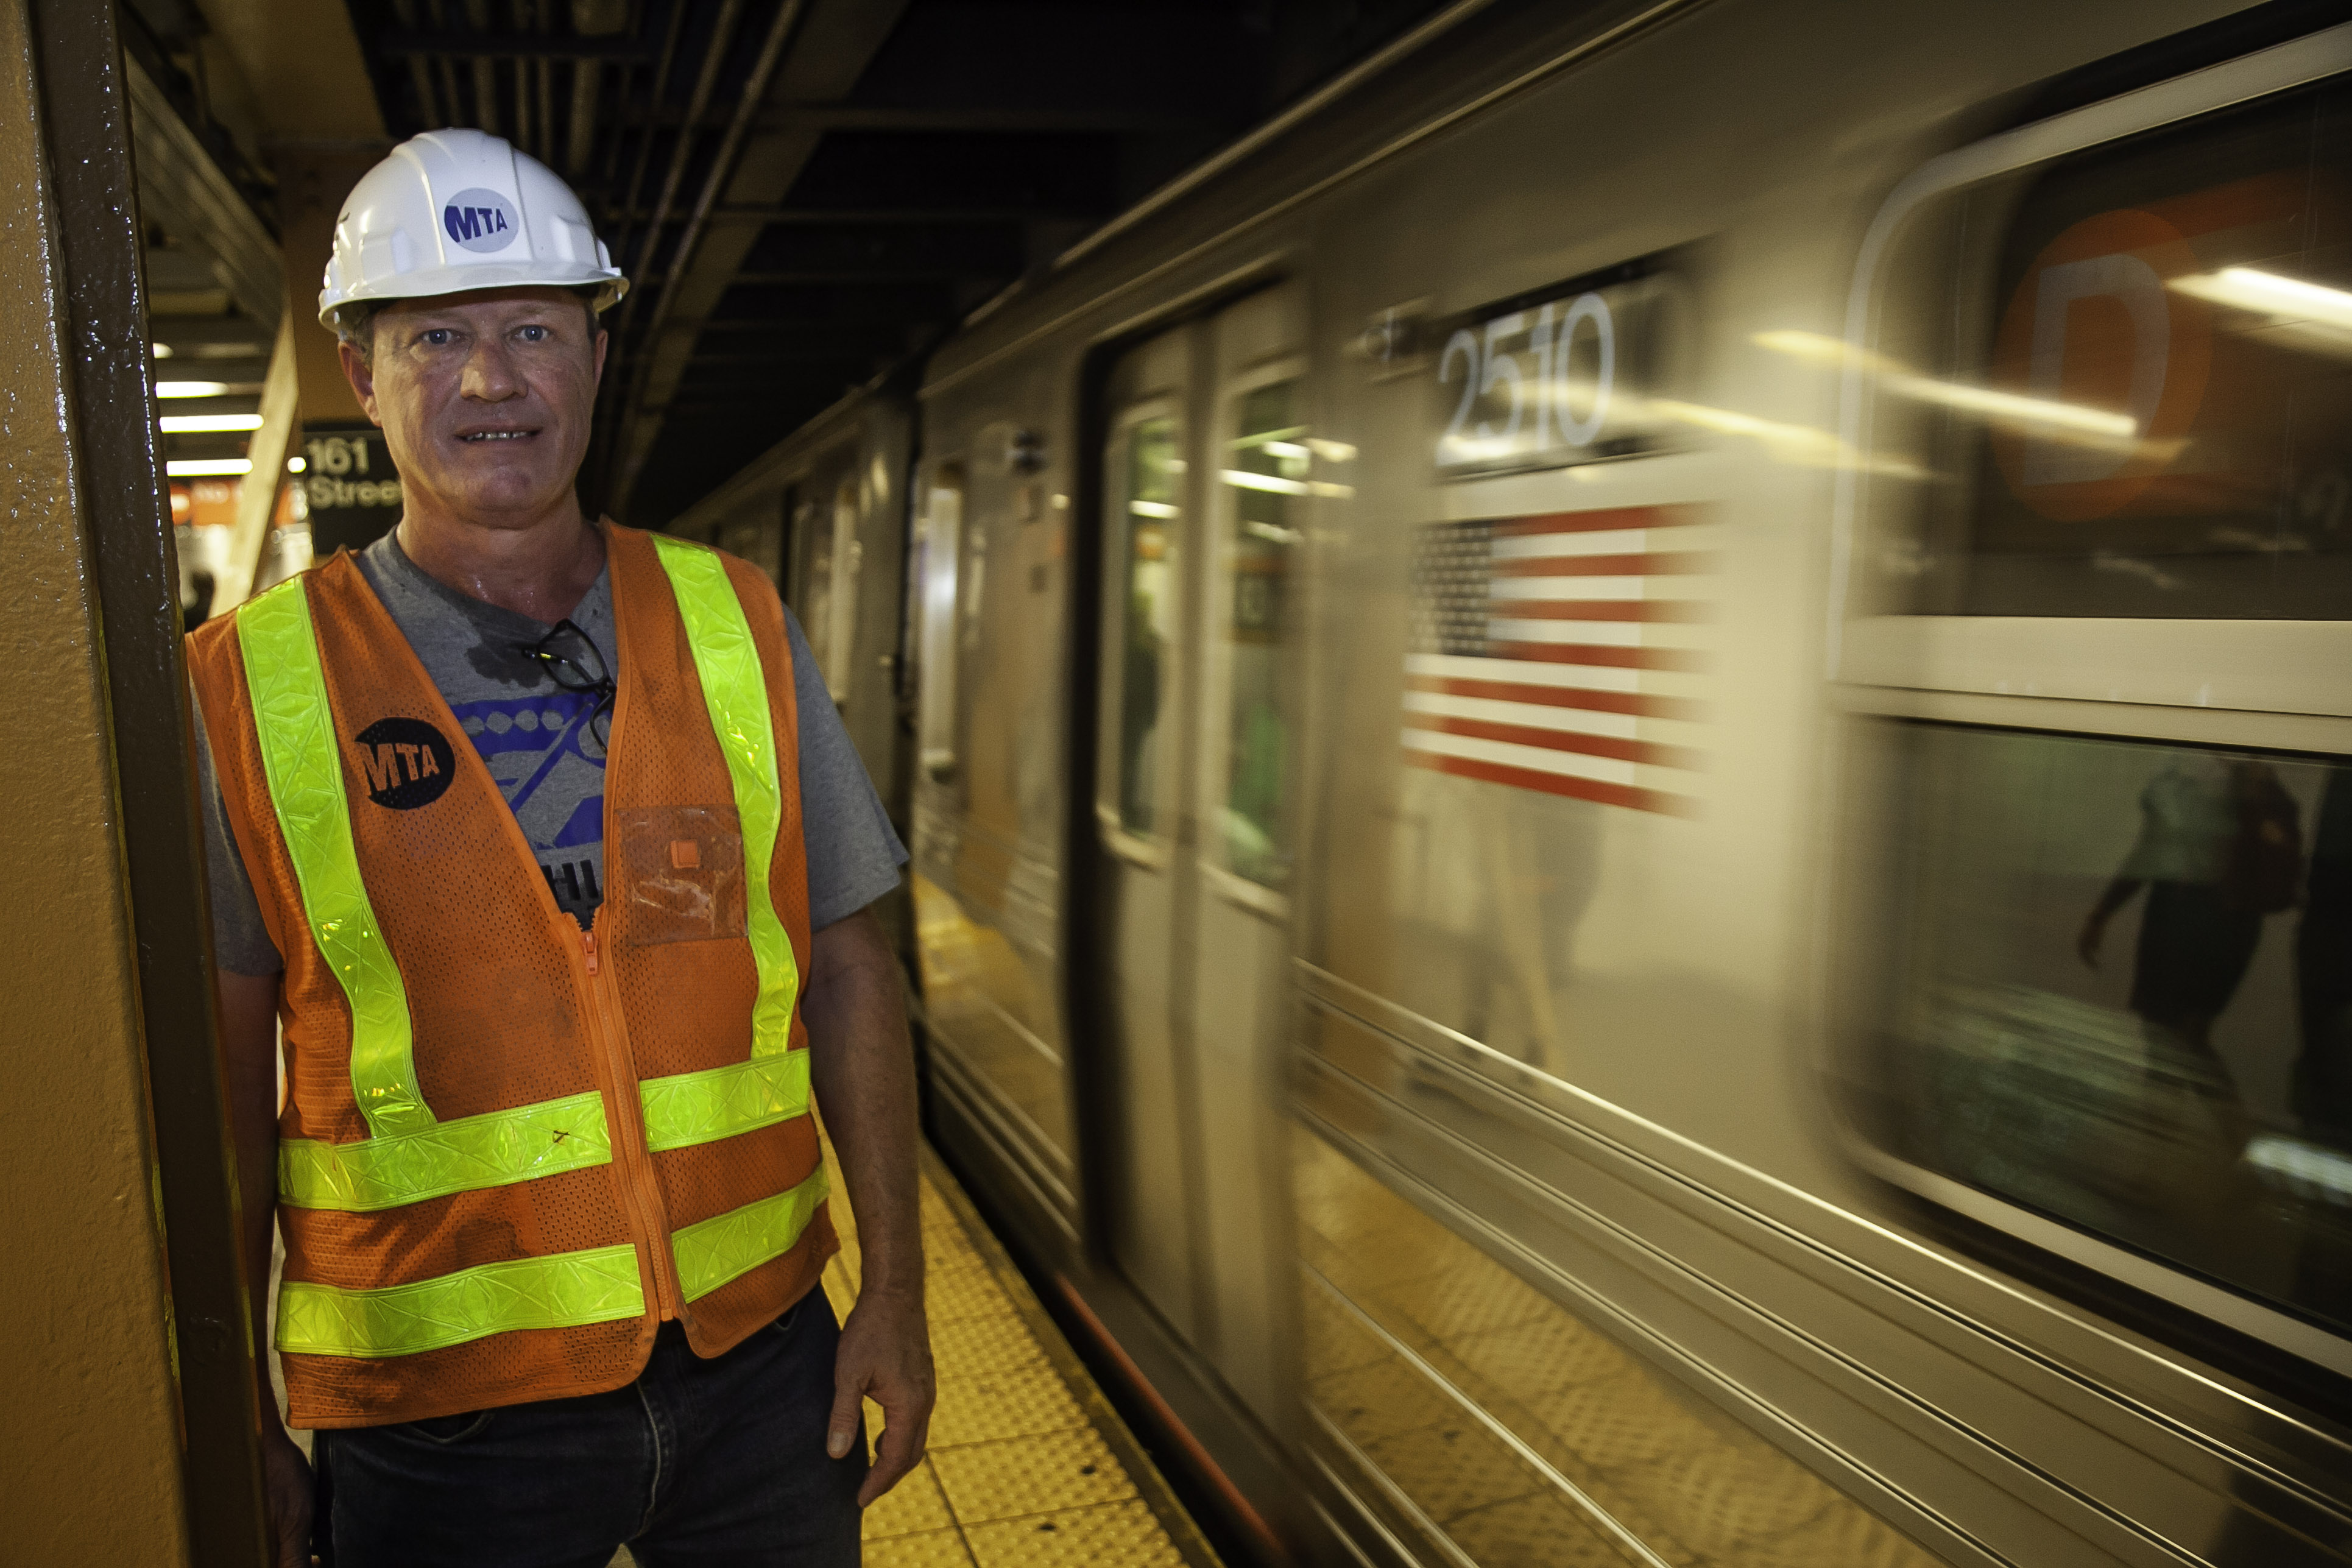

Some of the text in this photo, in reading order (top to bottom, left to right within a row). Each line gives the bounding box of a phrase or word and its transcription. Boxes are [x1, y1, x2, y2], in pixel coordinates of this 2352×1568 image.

[444, 205, 508, 243] MTA
[1434, 292, 1615, 467] 2510
[2022, 252, 2170, 486] D
[308, 438, 369, 473] 161
[309, 475, 403, 508] Stree
[355, 742, 440, 795] MTA
